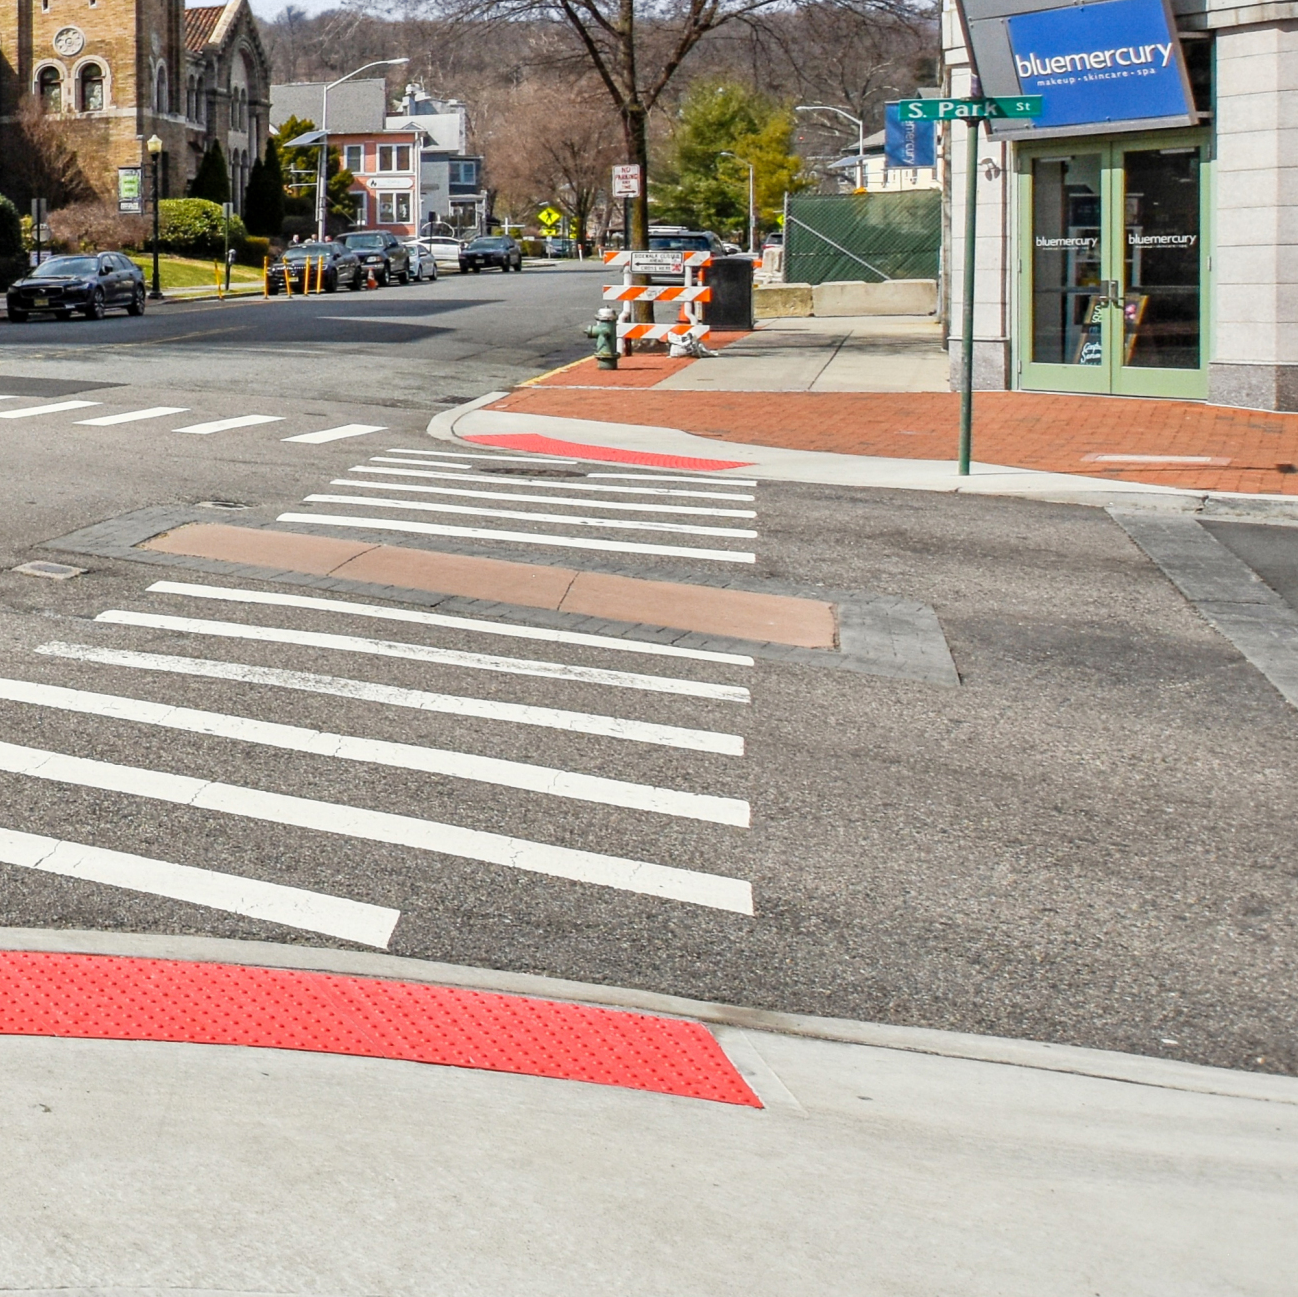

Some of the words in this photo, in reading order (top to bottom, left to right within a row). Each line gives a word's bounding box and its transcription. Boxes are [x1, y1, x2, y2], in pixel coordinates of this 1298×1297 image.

[1015, 42, 1173, 79] bluemercury
[1037, 76, 1076, 87] makeup
[1083, 70, 1129, 82] skincare
[1137, 67, 1156, 77] spa
[908, 102, 928, 119] S.
[938, 101, 998, 118] Park
[1016, 101, 1032, 112] St
[902, 120, 916, 165] mercury
[1036, 236, 1098, 247] bluemercury
[1129, 234, 1197, 245] bluemercury
